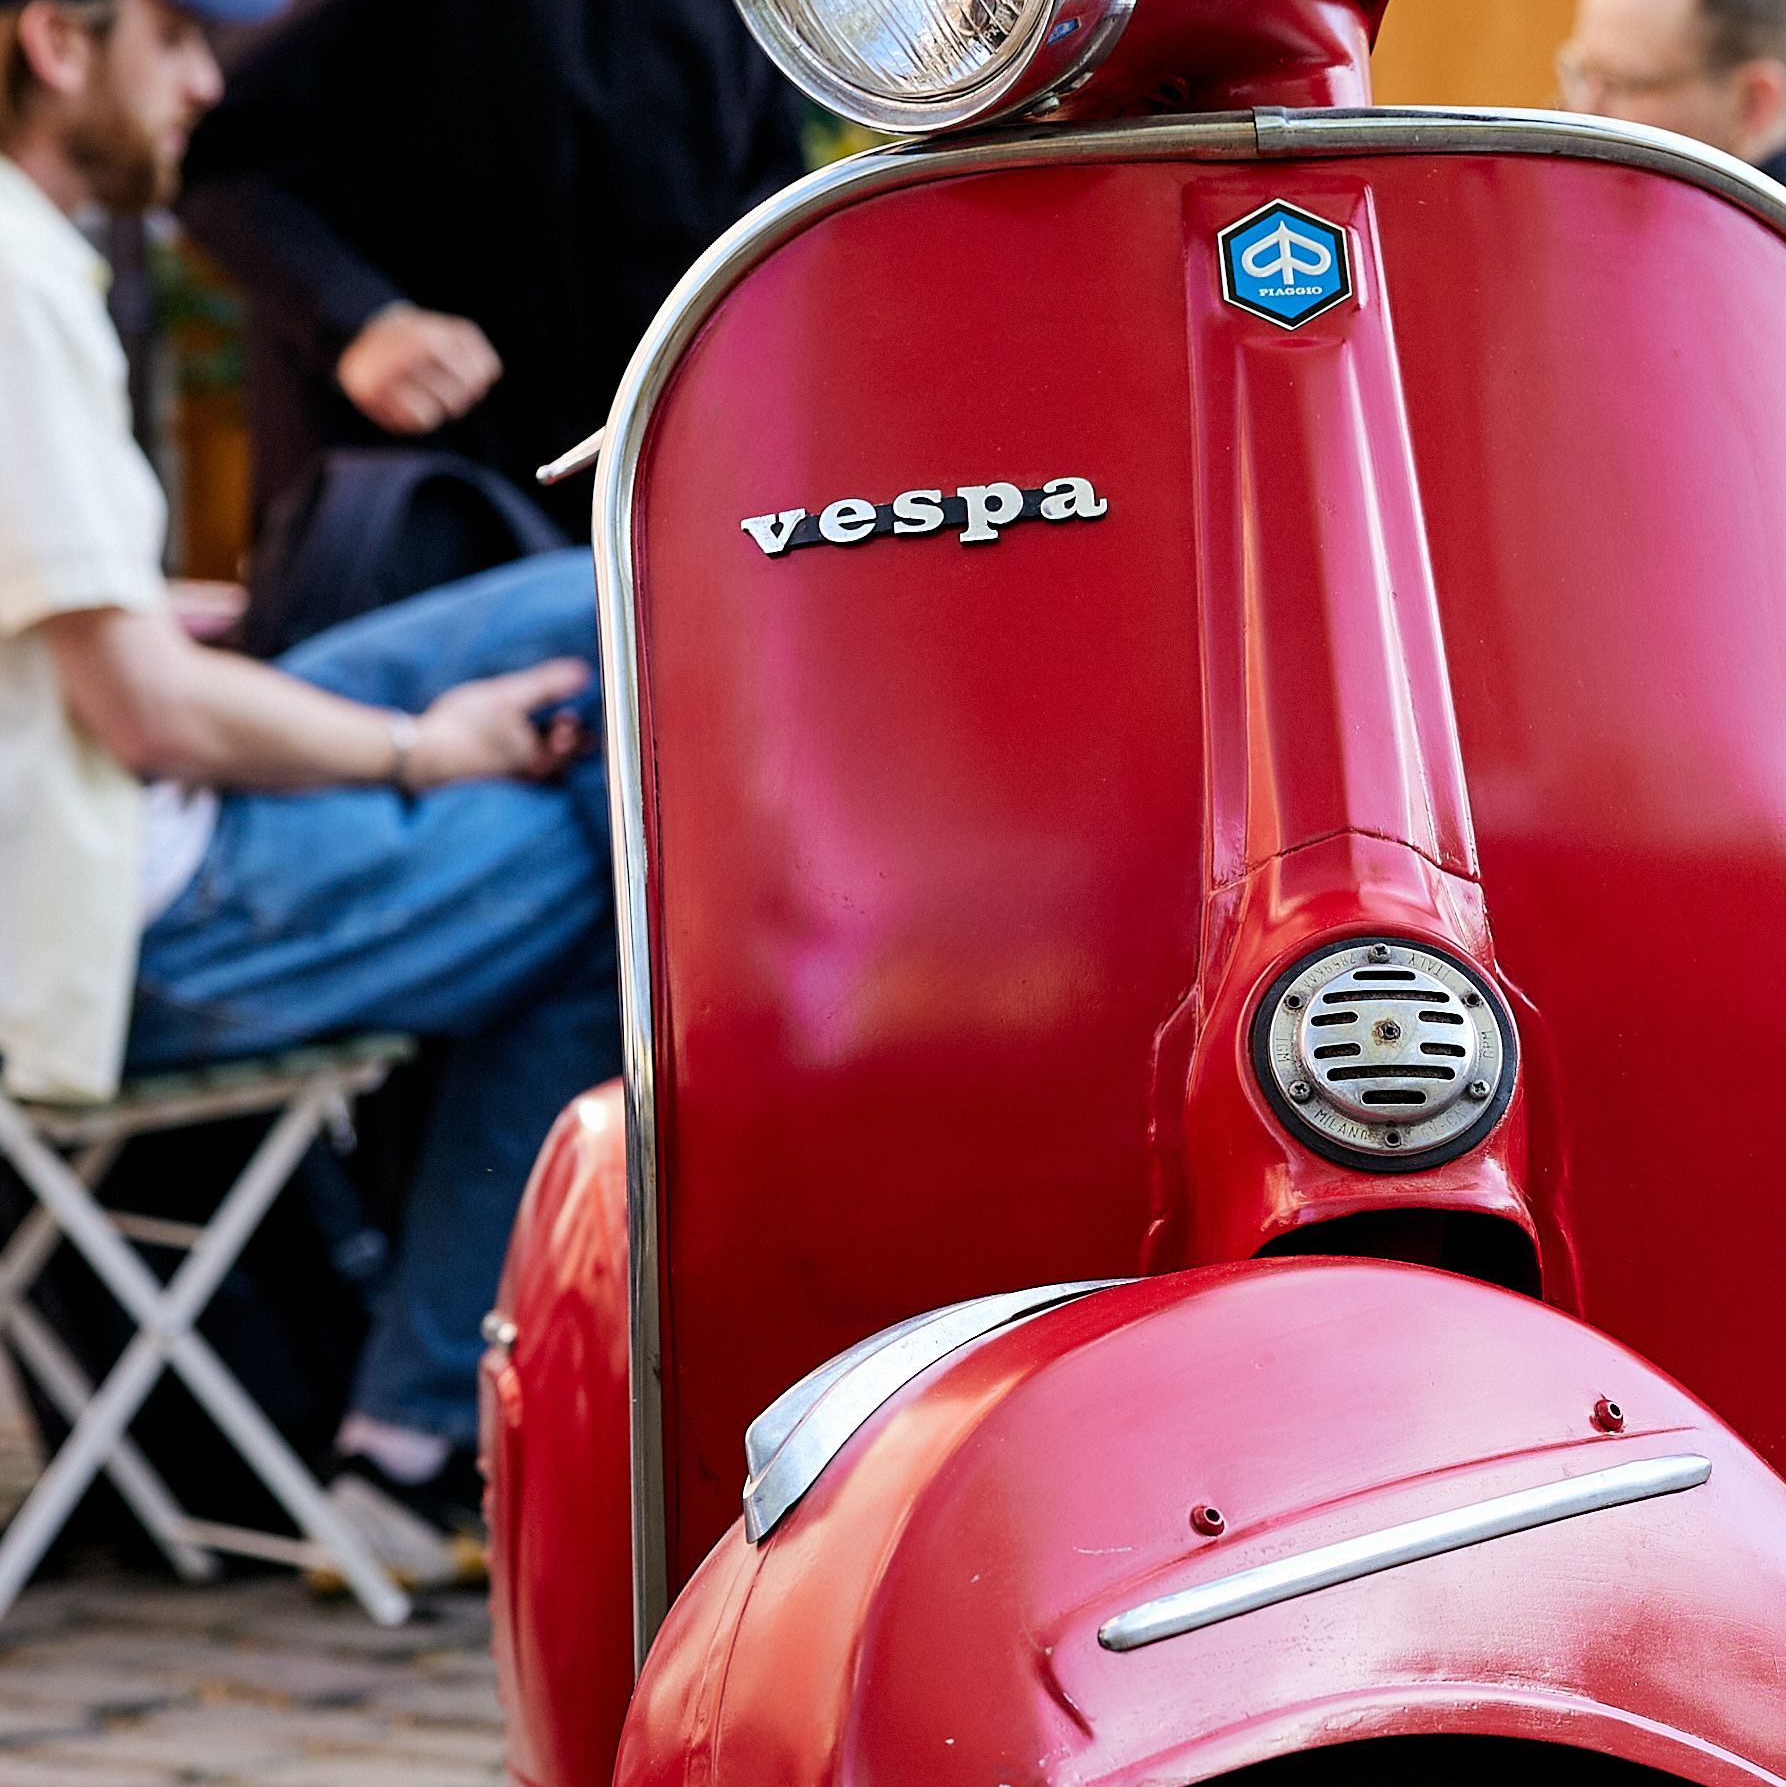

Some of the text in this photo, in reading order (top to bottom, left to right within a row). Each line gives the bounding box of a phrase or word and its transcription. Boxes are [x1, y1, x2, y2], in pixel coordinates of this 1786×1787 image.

[1258, 286, 1323, 297] PIAGGIO
[740, 476, 1108, 556] vespa
[1408, 953, 1452, 982] ITALY
